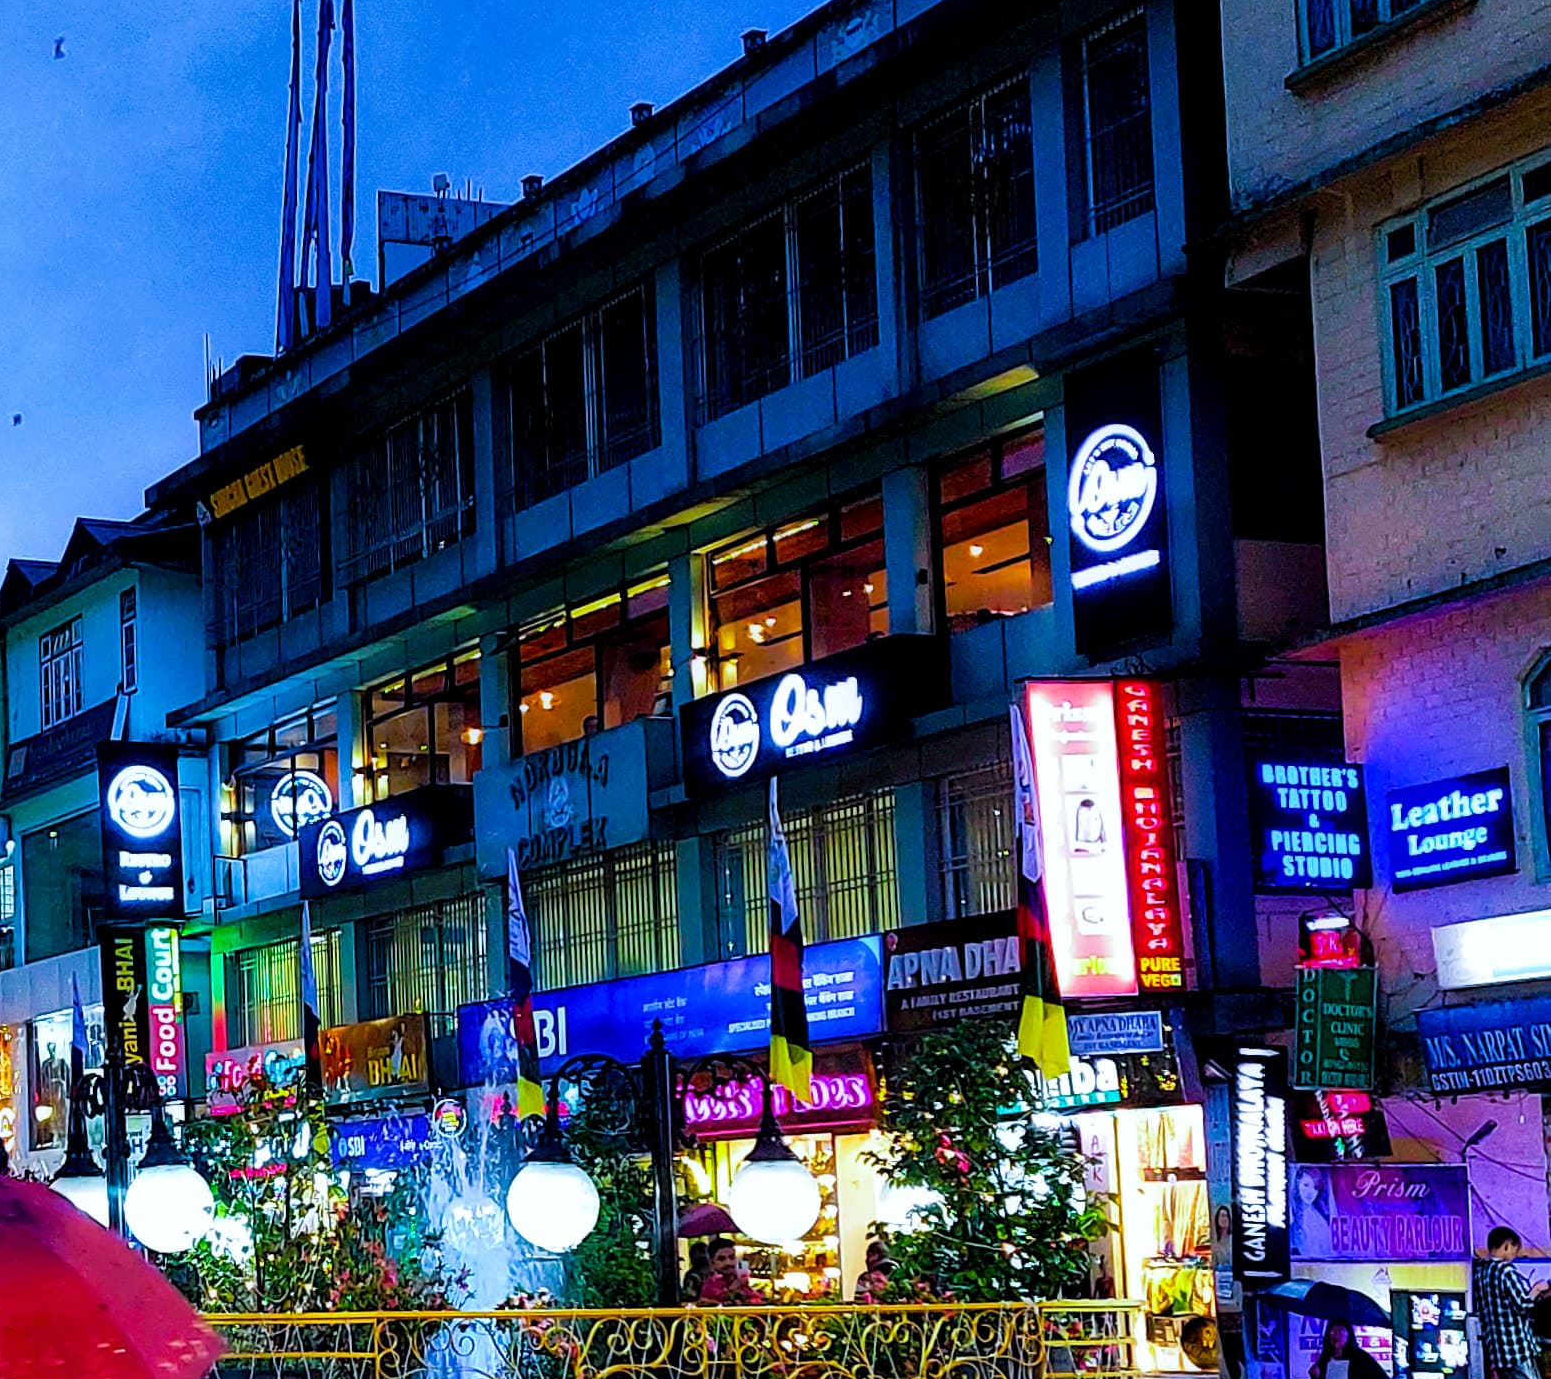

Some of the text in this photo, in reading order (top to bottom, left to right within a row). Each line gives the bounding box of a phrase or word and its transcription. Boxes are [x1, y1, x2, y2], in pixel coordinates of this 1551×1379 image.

[1262, 764, 1359, 789] BROTHER'S
[1277, 788, 1347, 812] TATTOO
[1391, 788, 1503, 832] Leather
[1271, 830, 1360, 855] PIERCING
[1407, 827, 1488, 856] Lounge
[1282, 855, 1353, 879] STUDIO
[115, 938, 135, 992] BHAI
[151, 928, 174, 1002] Court
[887, 946, 963, 991] APNA
[964, 935, 1022, 980] DHA
[1140, 957, 1181, 972] PURE
[119, 1021, 144, 1065] yani
[153, 1008, 177, 1072] Food
[1300, 968, 1316, 1085] DOCTOR
[1331, 1021, 1365, 1036] CLINIC
[1461, 1026, 1526, 1066] NARPAT
[1530, 1024, 1551, 1058] SI
[348, 1136, 366, 1157] SBI
[1352, 1171, 1431, 1198] Prism
[1241, 1188, 1266, 1262] GANESH
[1330, 1215, 1465, 1254] BEAUTY PARLOUR
